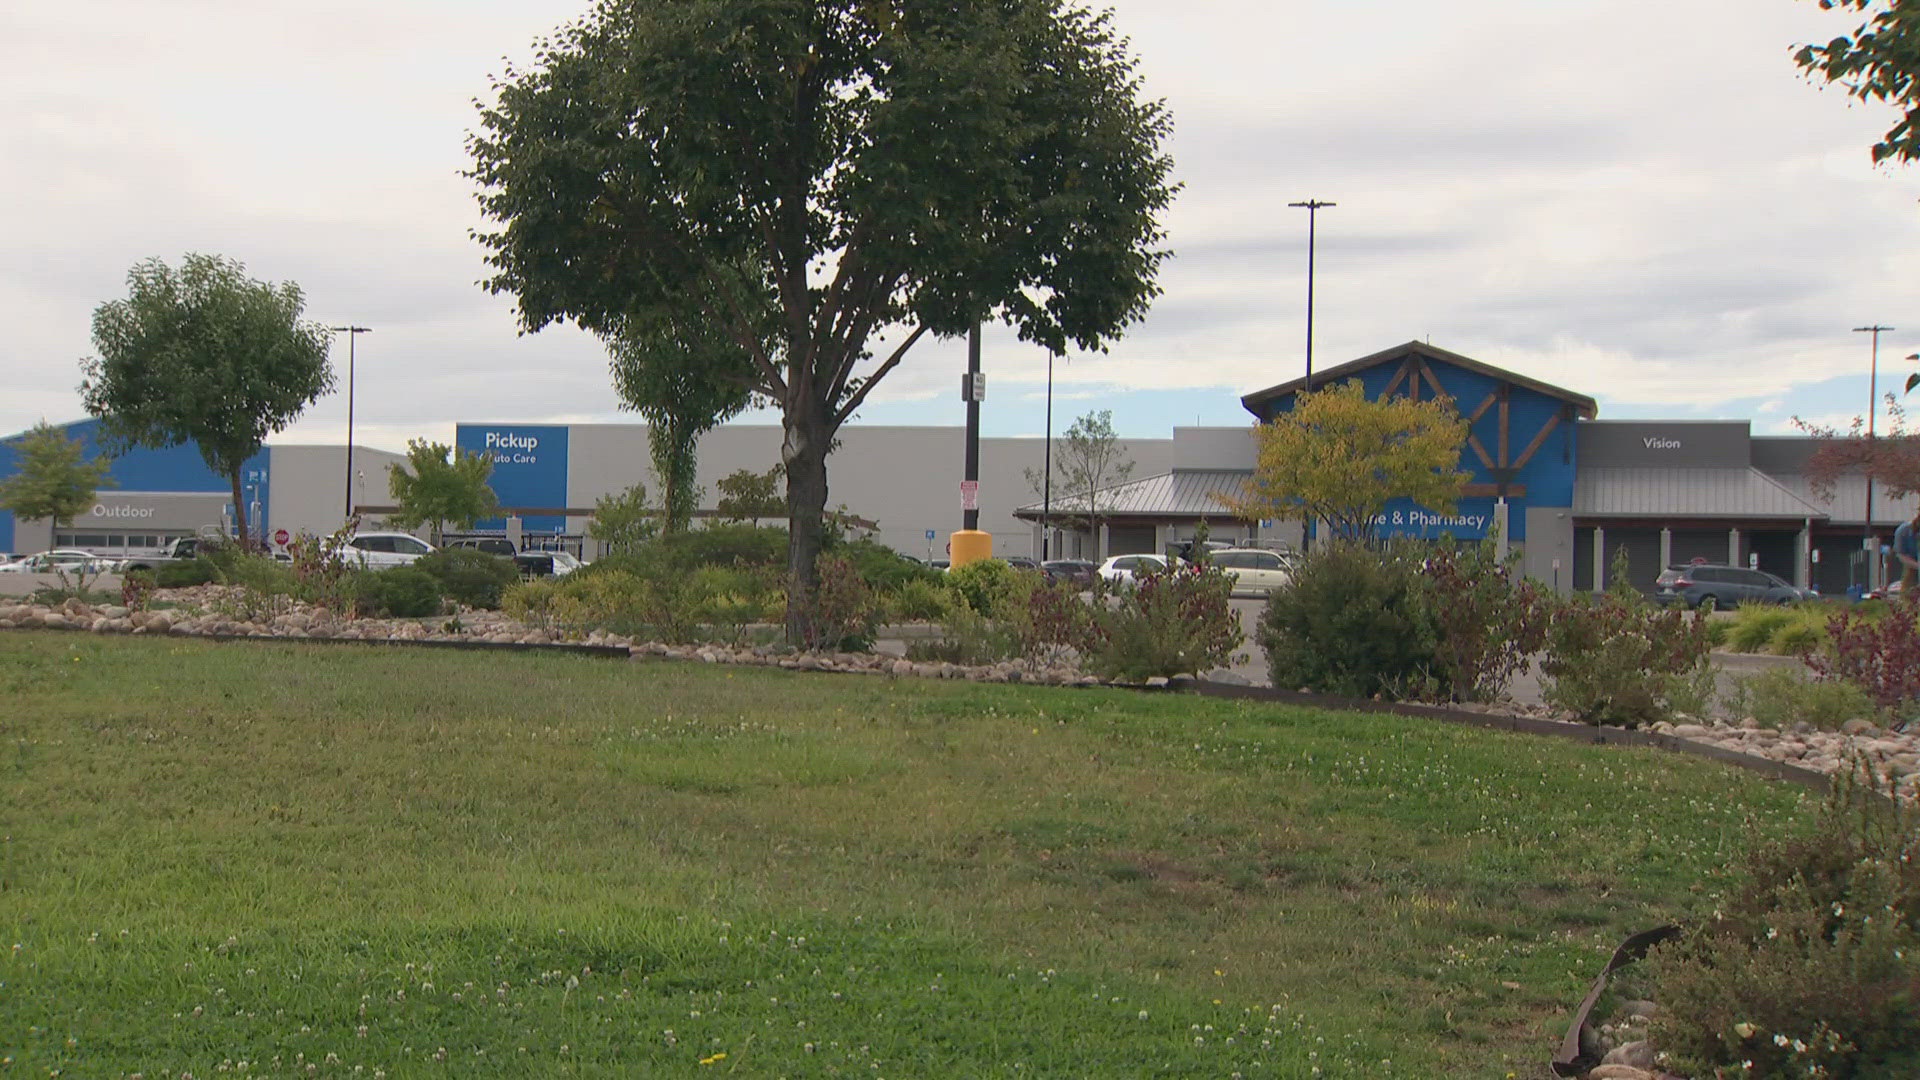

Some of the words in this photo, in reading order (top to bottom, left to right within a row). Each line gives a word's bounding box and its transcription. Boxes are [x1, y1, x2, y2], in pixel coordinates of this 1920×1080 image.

[485, 432, 538, 452] Pickup
[1643, 437, 1681, 449] Vision
[488, 453, 510, 463] uto
[513, 453, 537, 464] Care
[93, 504, 155, 518] Outdoor
[1392, 511, 1403, 525] &
[1409, 511, 1485, 530] Pharmacy
[276, 533, 288, 541] STOP
